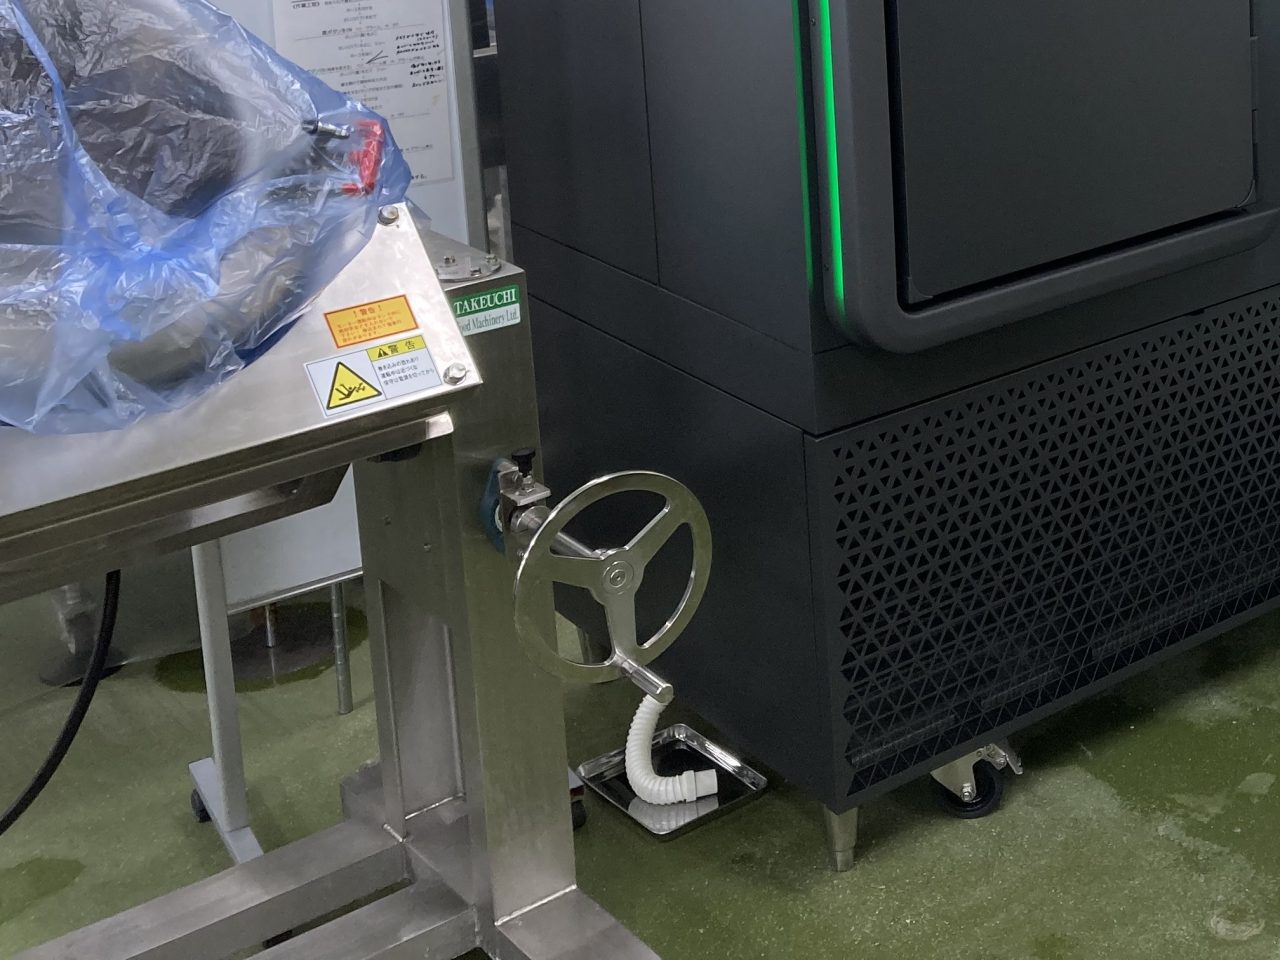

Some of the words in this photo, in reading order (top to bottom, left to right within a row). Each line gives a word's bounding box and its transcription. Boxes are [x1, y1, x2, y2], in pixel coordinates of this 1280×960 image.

[453, 288, 517, 315] TAKEUCHI
[471, 314, 505, 330] Machinery
[505, 309, 520, 322] Ltd.
[387, 340, 416, 354] 警告
